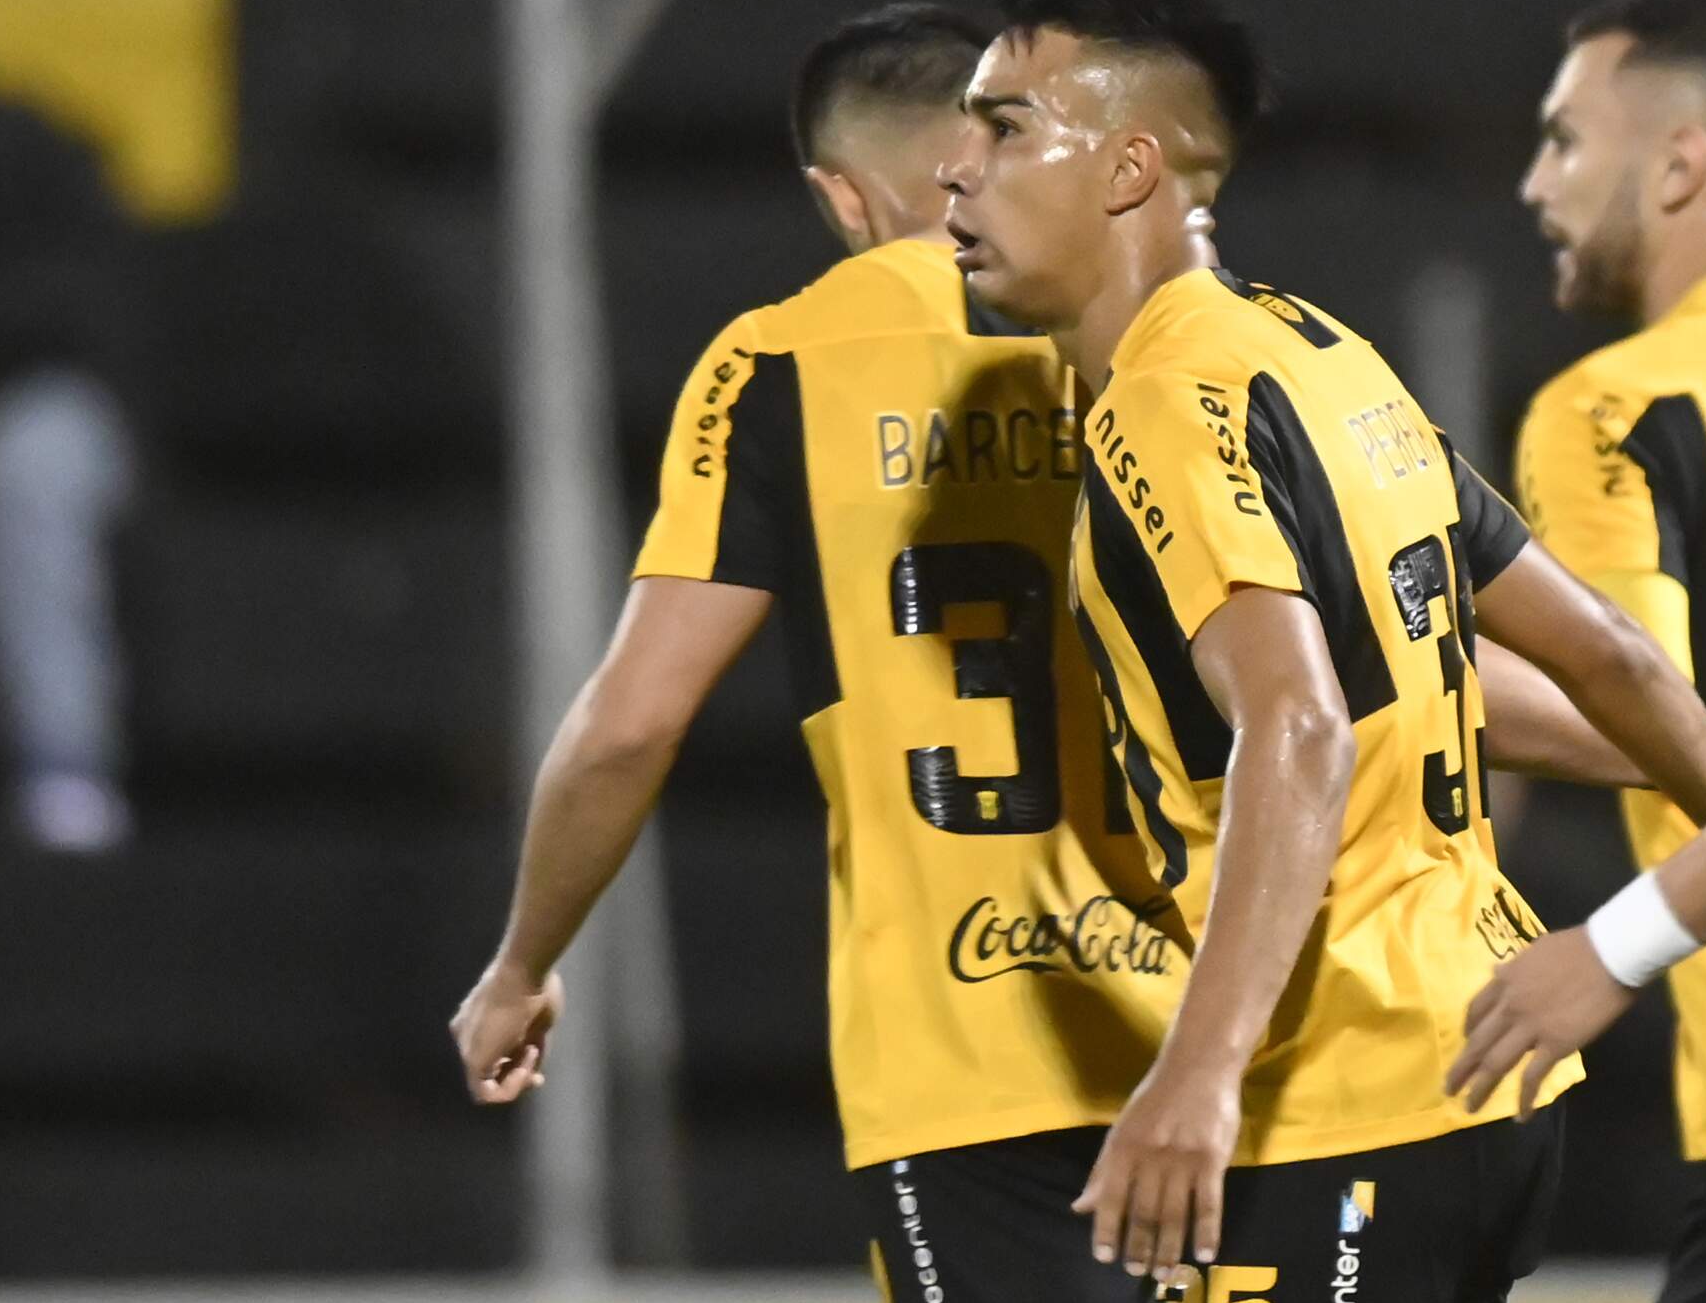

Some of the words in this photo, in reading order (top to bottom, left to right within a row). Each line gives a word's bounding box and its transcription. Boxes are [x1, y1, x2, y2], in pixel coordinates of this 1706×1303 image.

[874, 408, 1088, 489] BARCE
[1095, 379, 1175, 554] nissel
[890, 542, 1136, 836] 3
